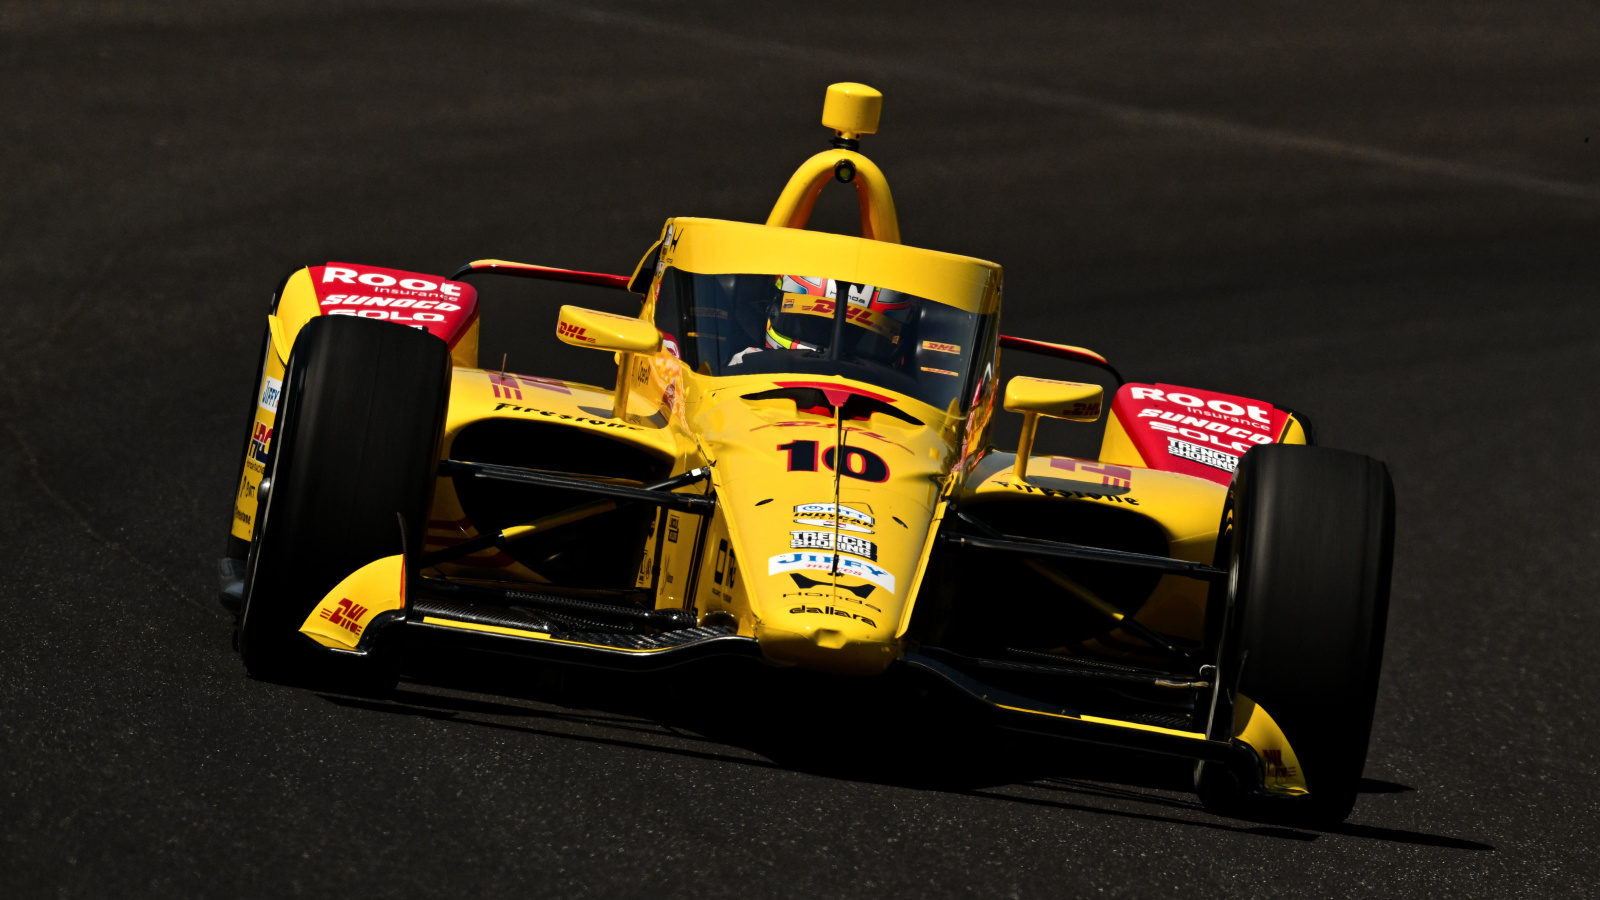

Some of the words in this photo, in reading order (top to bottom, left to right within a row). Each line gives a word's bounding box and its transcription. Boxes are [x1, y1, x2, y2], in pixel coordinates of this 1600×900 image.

[320, 294, 462, 312] SUNOCO
[374, 286, 459, 302] Insurance
[557, 321, 588, 342] DHL
[928, 342, 957, 354] DHL
[493, 402, 645, 431] Firestone
[1137, 408, 1273, 445] SUNOCO
[1187, 406, 1271, 432] Insurance
[776, 439, 891, 484] 10
[1167, 436, 1240, 466] TRENCH
[991, 480, 1140, 506] Firestone
[794, 512, 874, 528] INDYCAR
[782, 591, 882, 613] Honda
[789, 604, 878, 629] dallara
